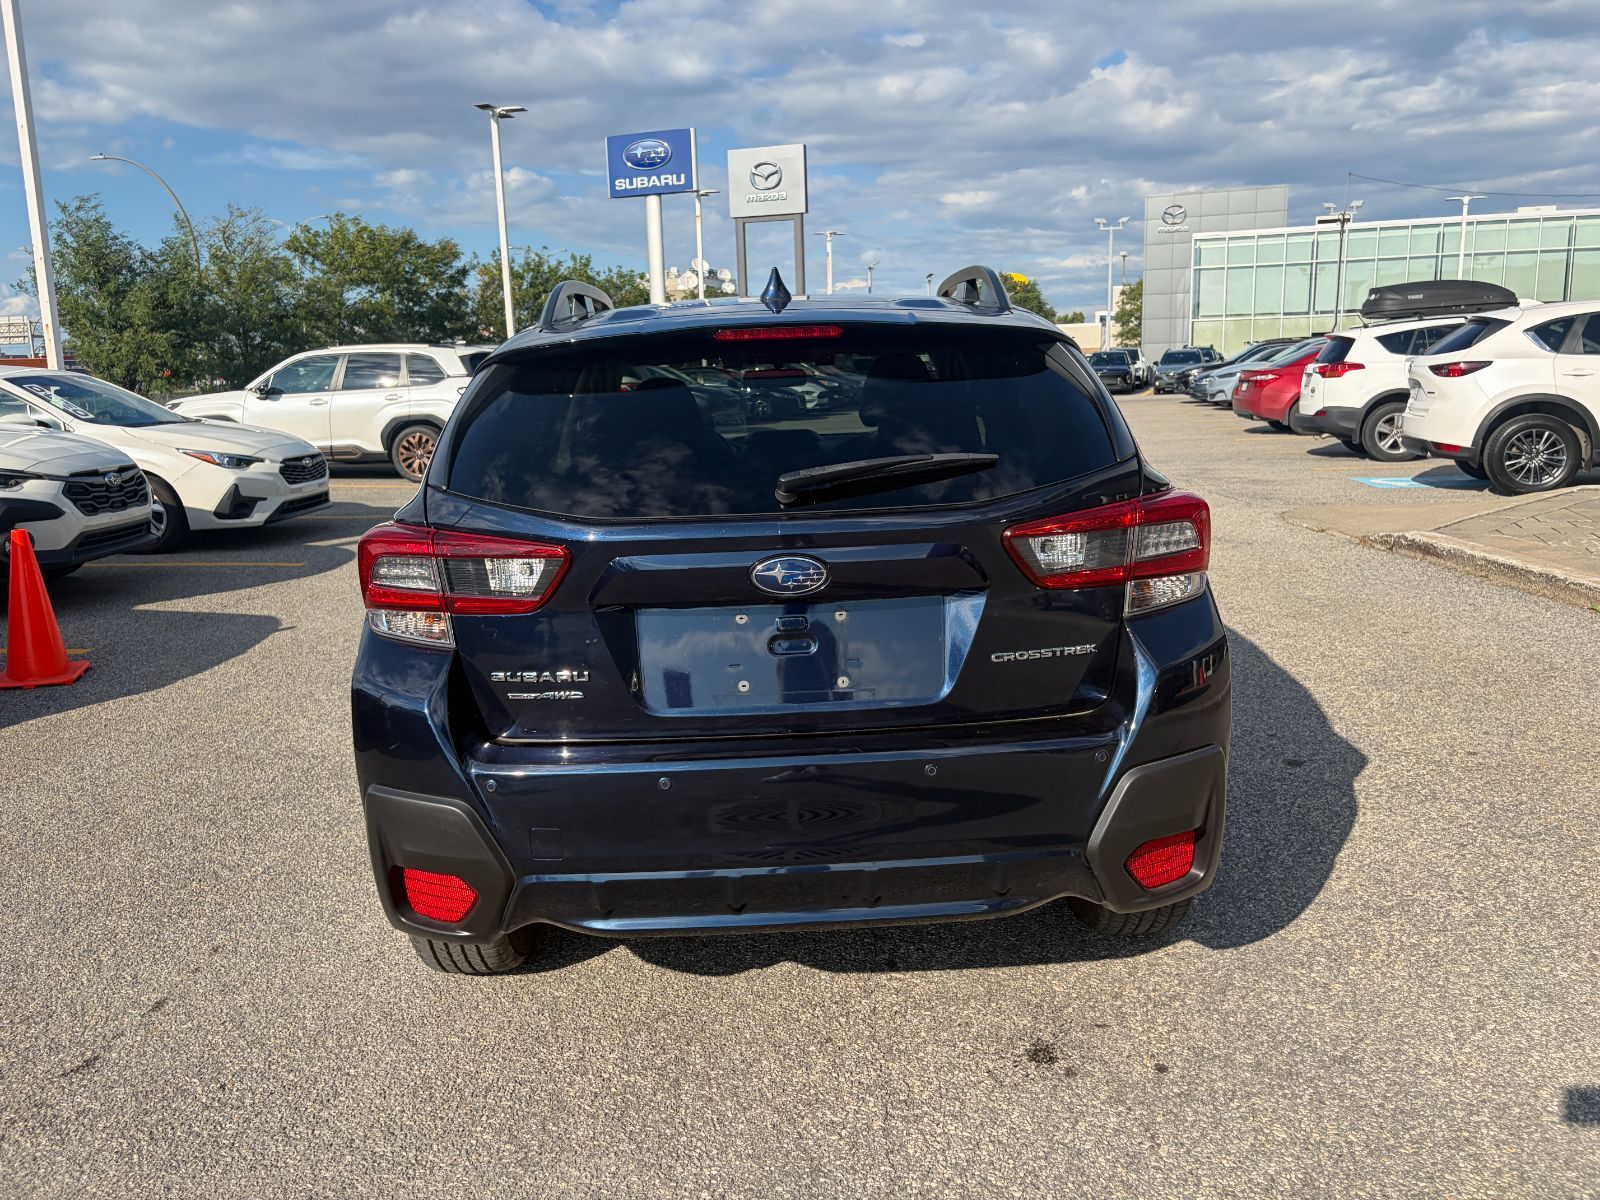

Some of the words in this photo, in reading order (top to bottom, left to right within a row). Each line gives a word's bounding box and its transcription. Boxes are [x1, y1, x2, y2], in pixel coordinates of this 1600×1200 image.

[615, 173, 685, 190] SUBARU
[991, 643, 1097, 662] CROSSTREK
[490, 671, 590, 683] SUBARU
